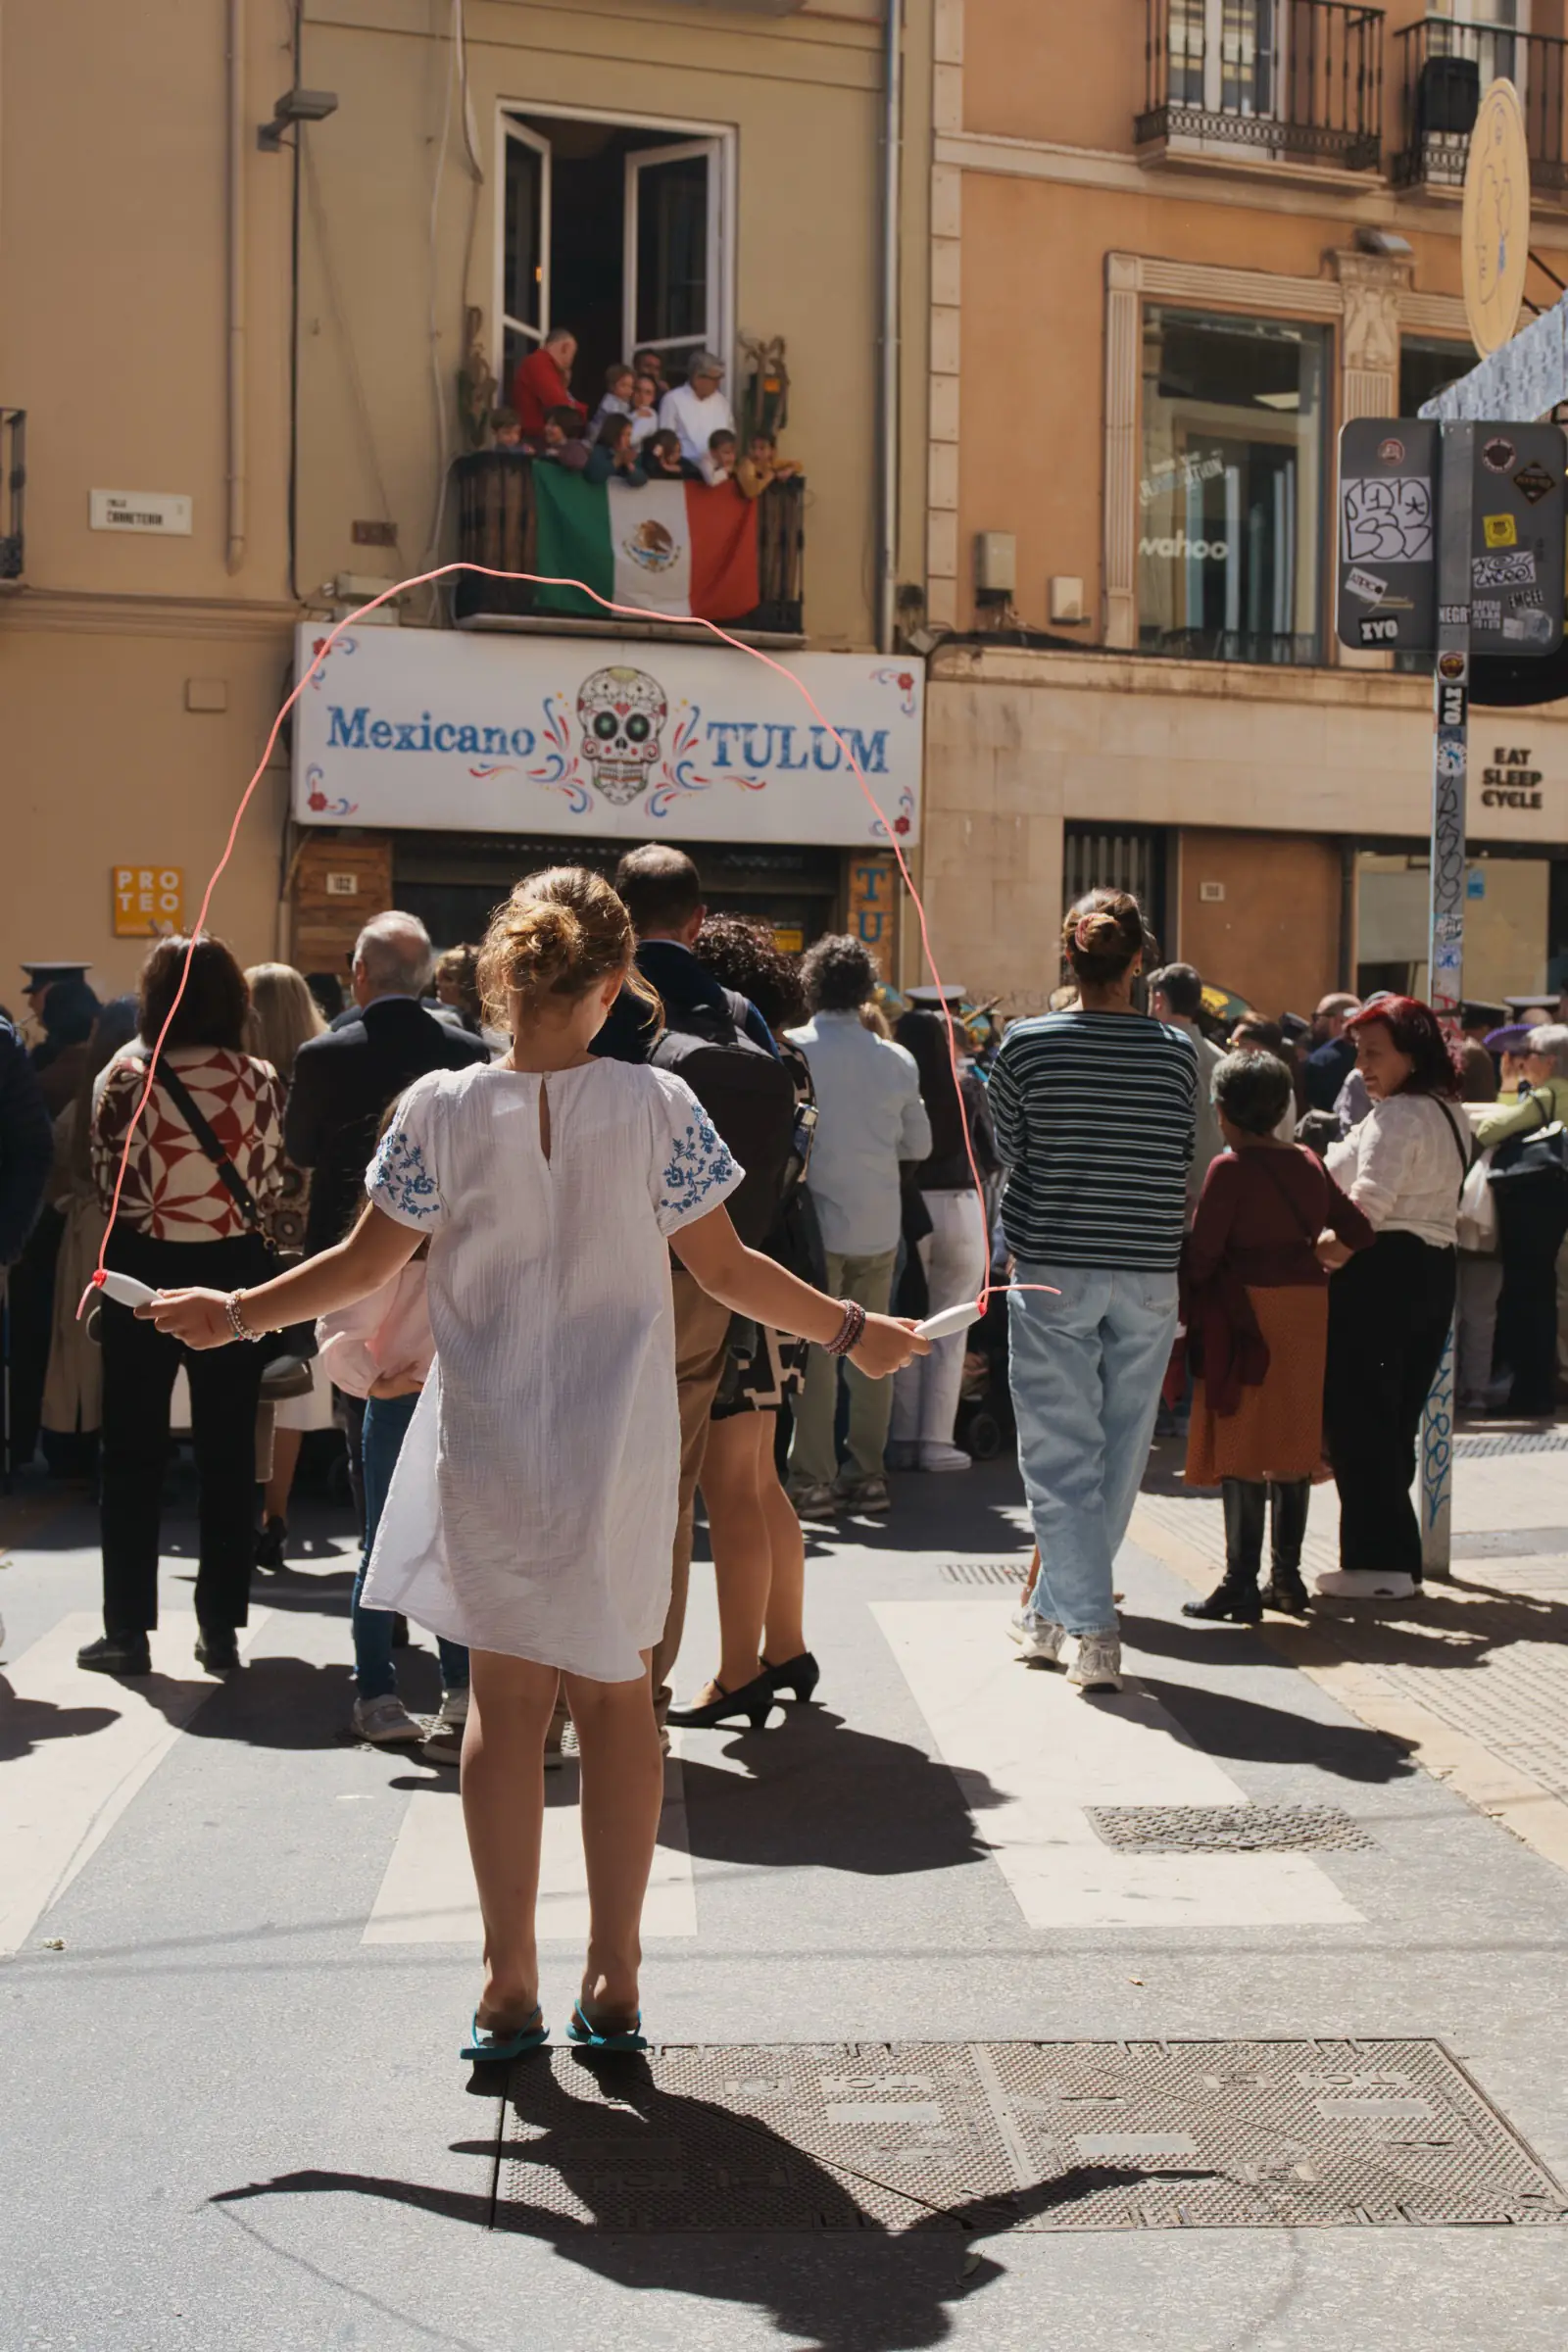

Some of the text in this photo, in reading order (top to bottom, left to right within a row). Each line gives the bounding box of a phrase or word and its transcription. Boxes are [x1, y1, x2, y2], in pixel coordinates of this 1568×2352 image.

[326, 706, 890, 773] Mexicano TULUM
[1494, 747, 1531, 765] EAT
[1483, 768, 1544, 788] SLEEP
[1481, 789, 1543, 810] CYCLE
[118, 870, 179, 891] PRO
[118, 892, 179, 911] TEO
